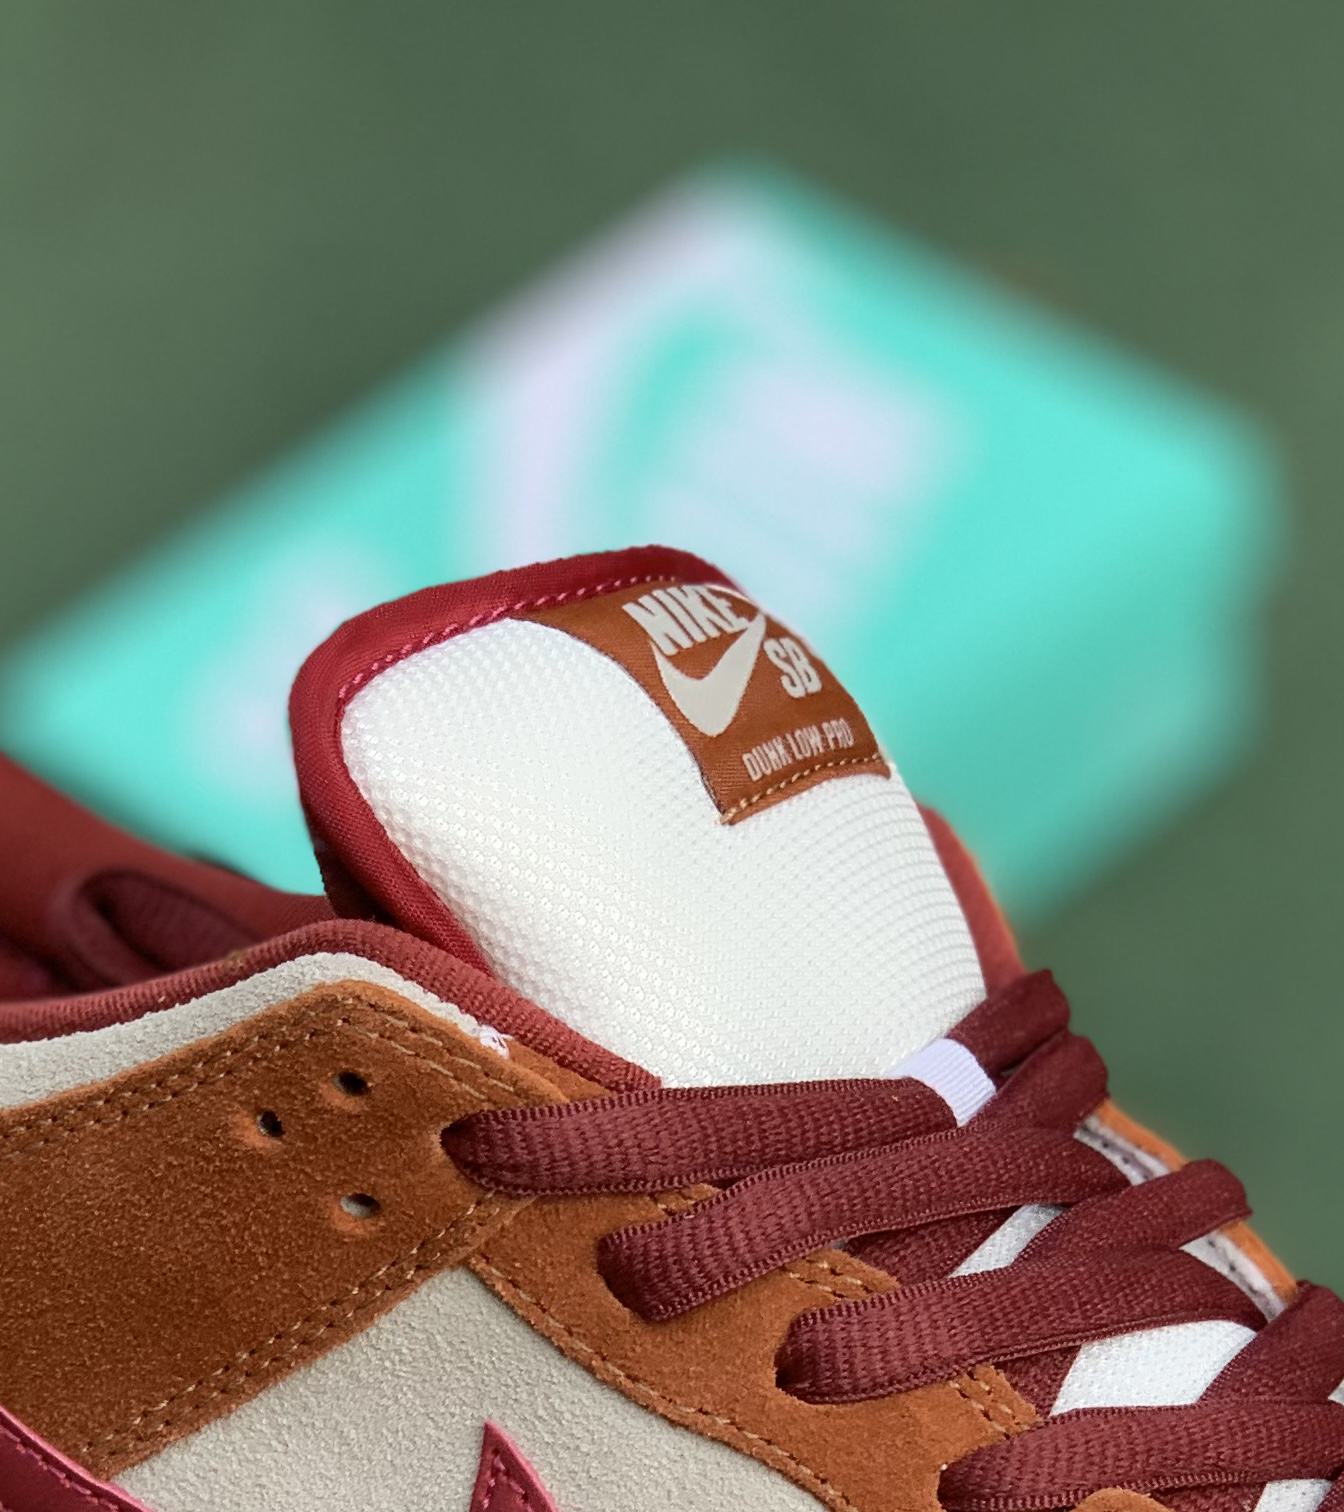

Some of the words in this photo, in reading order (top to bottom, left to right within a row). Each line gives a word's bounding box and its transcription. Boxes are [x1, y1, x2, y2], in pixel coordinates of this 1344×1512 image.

[622, 584, 752, 656] NIKE
[763, 637, 822, 698] SB
[742, 735, 793, 781] DUNK
[786, 724, 824, 760] LOW
[822, 718, 854, 751] PRO
